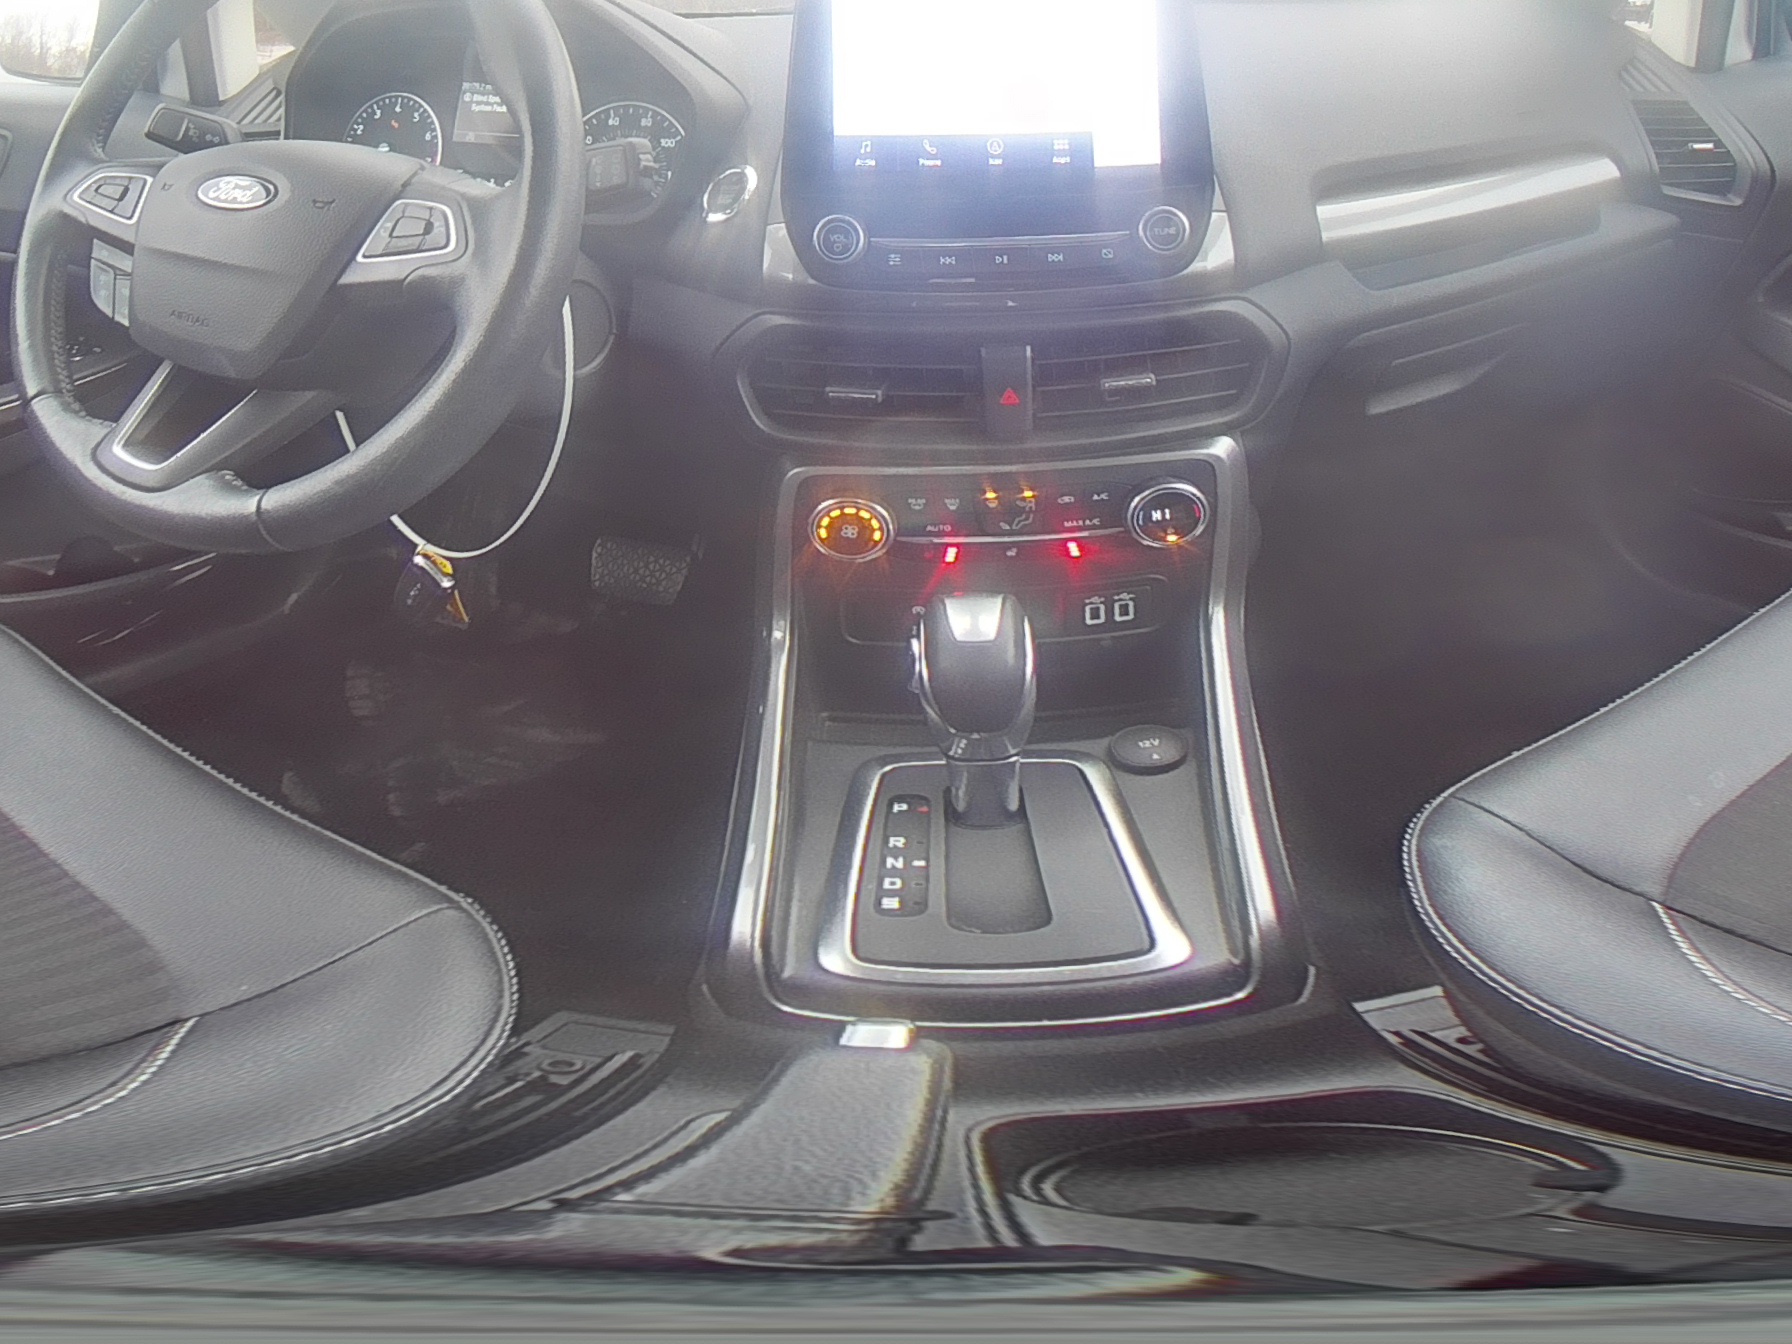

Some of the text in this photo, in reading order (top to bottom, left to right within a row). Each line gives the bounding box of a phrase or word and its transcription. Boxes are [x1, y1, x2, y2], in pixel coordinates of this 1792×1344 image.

[395, 105, 403, 113] 4
[374, 110, 382, 120] 3
[413, 113, 420, 123] 5
[608, 117, 619, 126] 60
[640, 118, 652, 127] 80
[356, 125, 364, 135] 2
[425, 131, 432, 141] 6
[660, 138, 676, 148] 100
[209, 178, 258, 203] Ford
[1153, 226, 1177, 236] TUNE
[169, 309, 210, 329] AIRBAG
[1092, 492, 1110, 501] A/C
[925, 523, 953, 533] AUTO
[1064, 517, 1101, 529] MAX A/C
[1137, 738, 1160, 749] 12V
[892, 802, 909, 813] P
[888, 837, 906, 848] R
[886, 856, 904, 869] N
[883, 877, 903, 889] D
[880, 896, 901, 909] S
